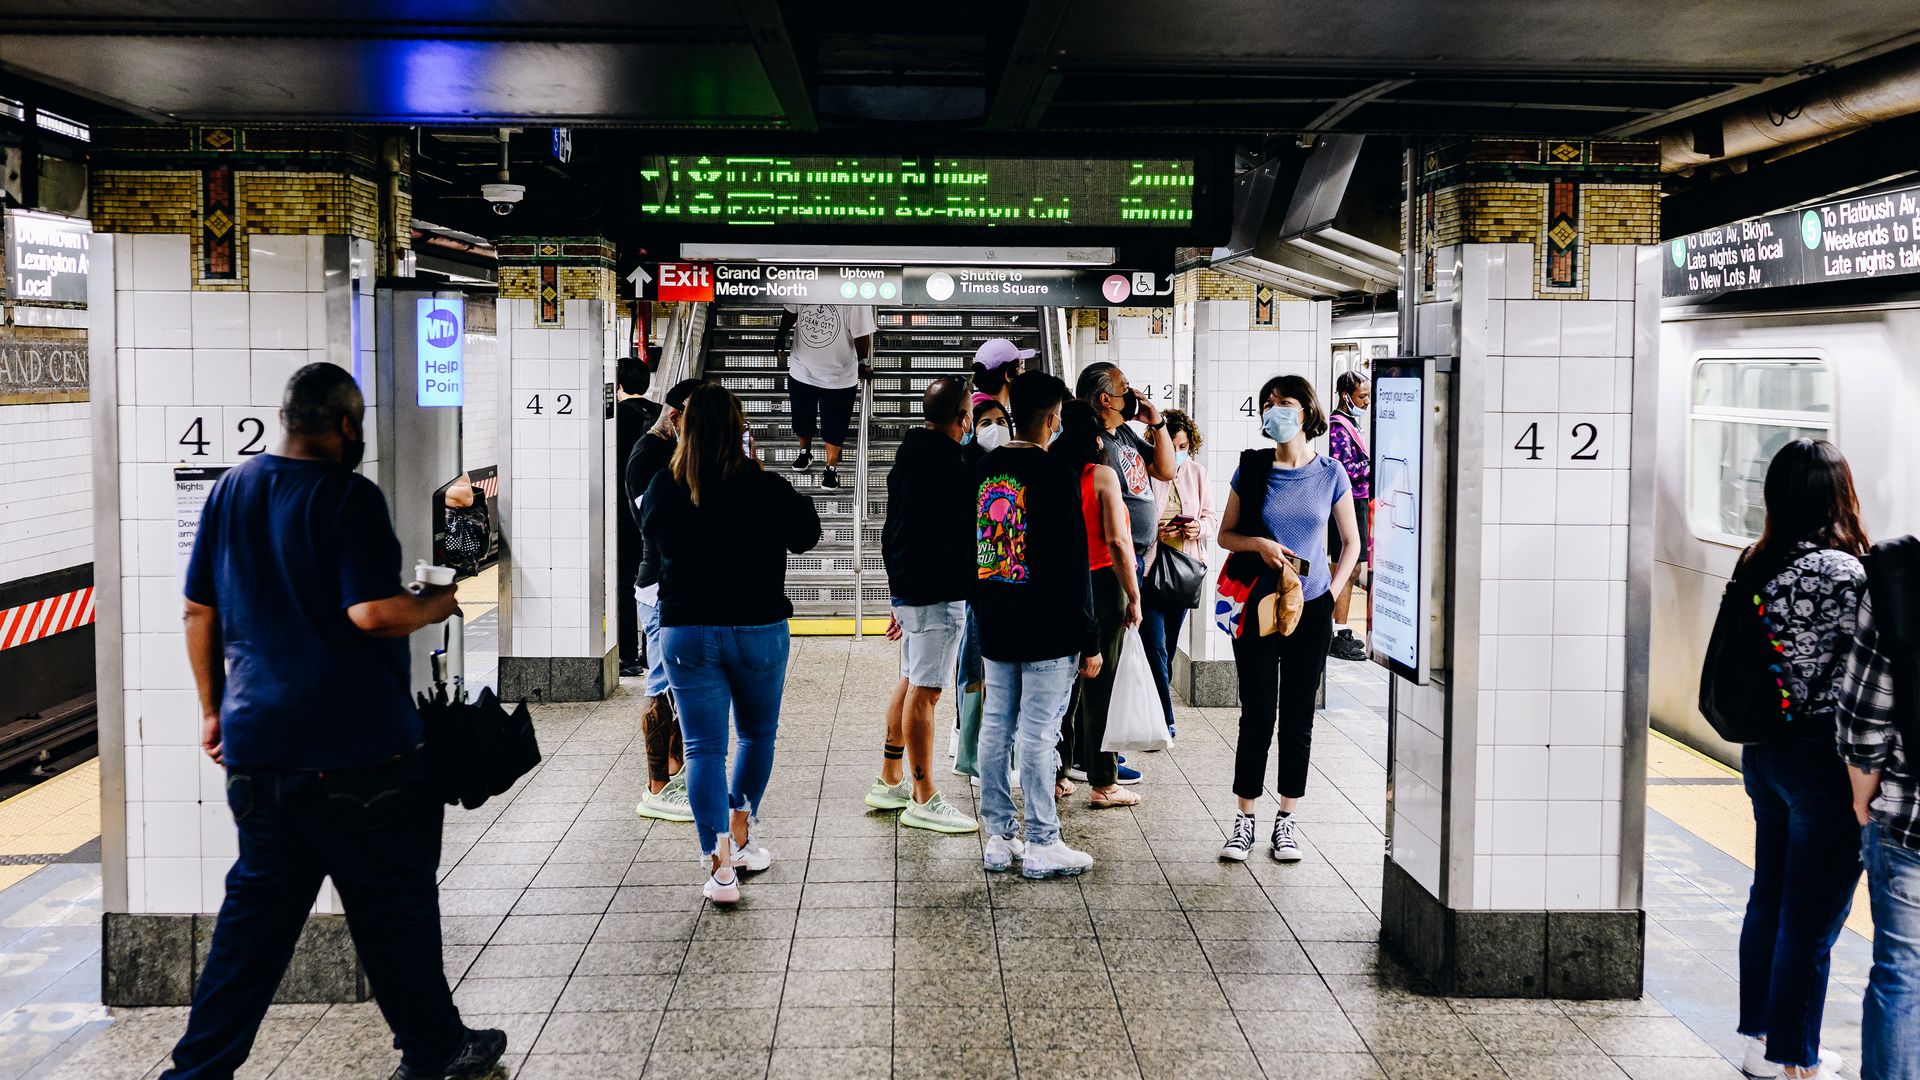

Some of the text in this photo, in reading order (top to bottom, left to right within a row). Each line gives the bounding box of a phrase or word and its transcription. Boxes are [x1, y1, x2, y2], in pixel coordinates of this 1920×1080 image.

[1821, 206, 1837, 228] To
[1840, 196, 1895, 225] Flatbush
[1899, 193, 1920, 218] Av,
[1699, 230, 1723, 248] Utica
[1726, 226, 1740, 246] Av,
[1742, 221, 1774, 242] Bklyn.
[1822, 223, 1890, 252] Weekends
[1893, 221, 1909, 243] to
[16, 246, 77, 277] Lexington
[1687, 238, 1784, 271] Late nights via local
[1824, 254, 1852, 276] Late
[1855, 249, 1896, 277] nights
[659, 265, 709, 288] Exit
[716, 266, 819, 281] Grand Central
[839, 267, 885, 282] Uptown
[960, 270, 1023, 282] Shuttle to
[1688, 265, 1761, 291] to New Lots Av
[17, 273, 52, 297] Local
[716, 282, 808, 297] Metro-North
[960, 282, 1049, 295] Times Square
[1110, 280, 1122, 297] 7
[426, 318, 455, 340] MTA
[0, 349, 86, 384] AND CEN
[425, 360, 459, 374] Help
[1239, 396, 1256, 417] 4
[176, 482, 204, 492] Nights
